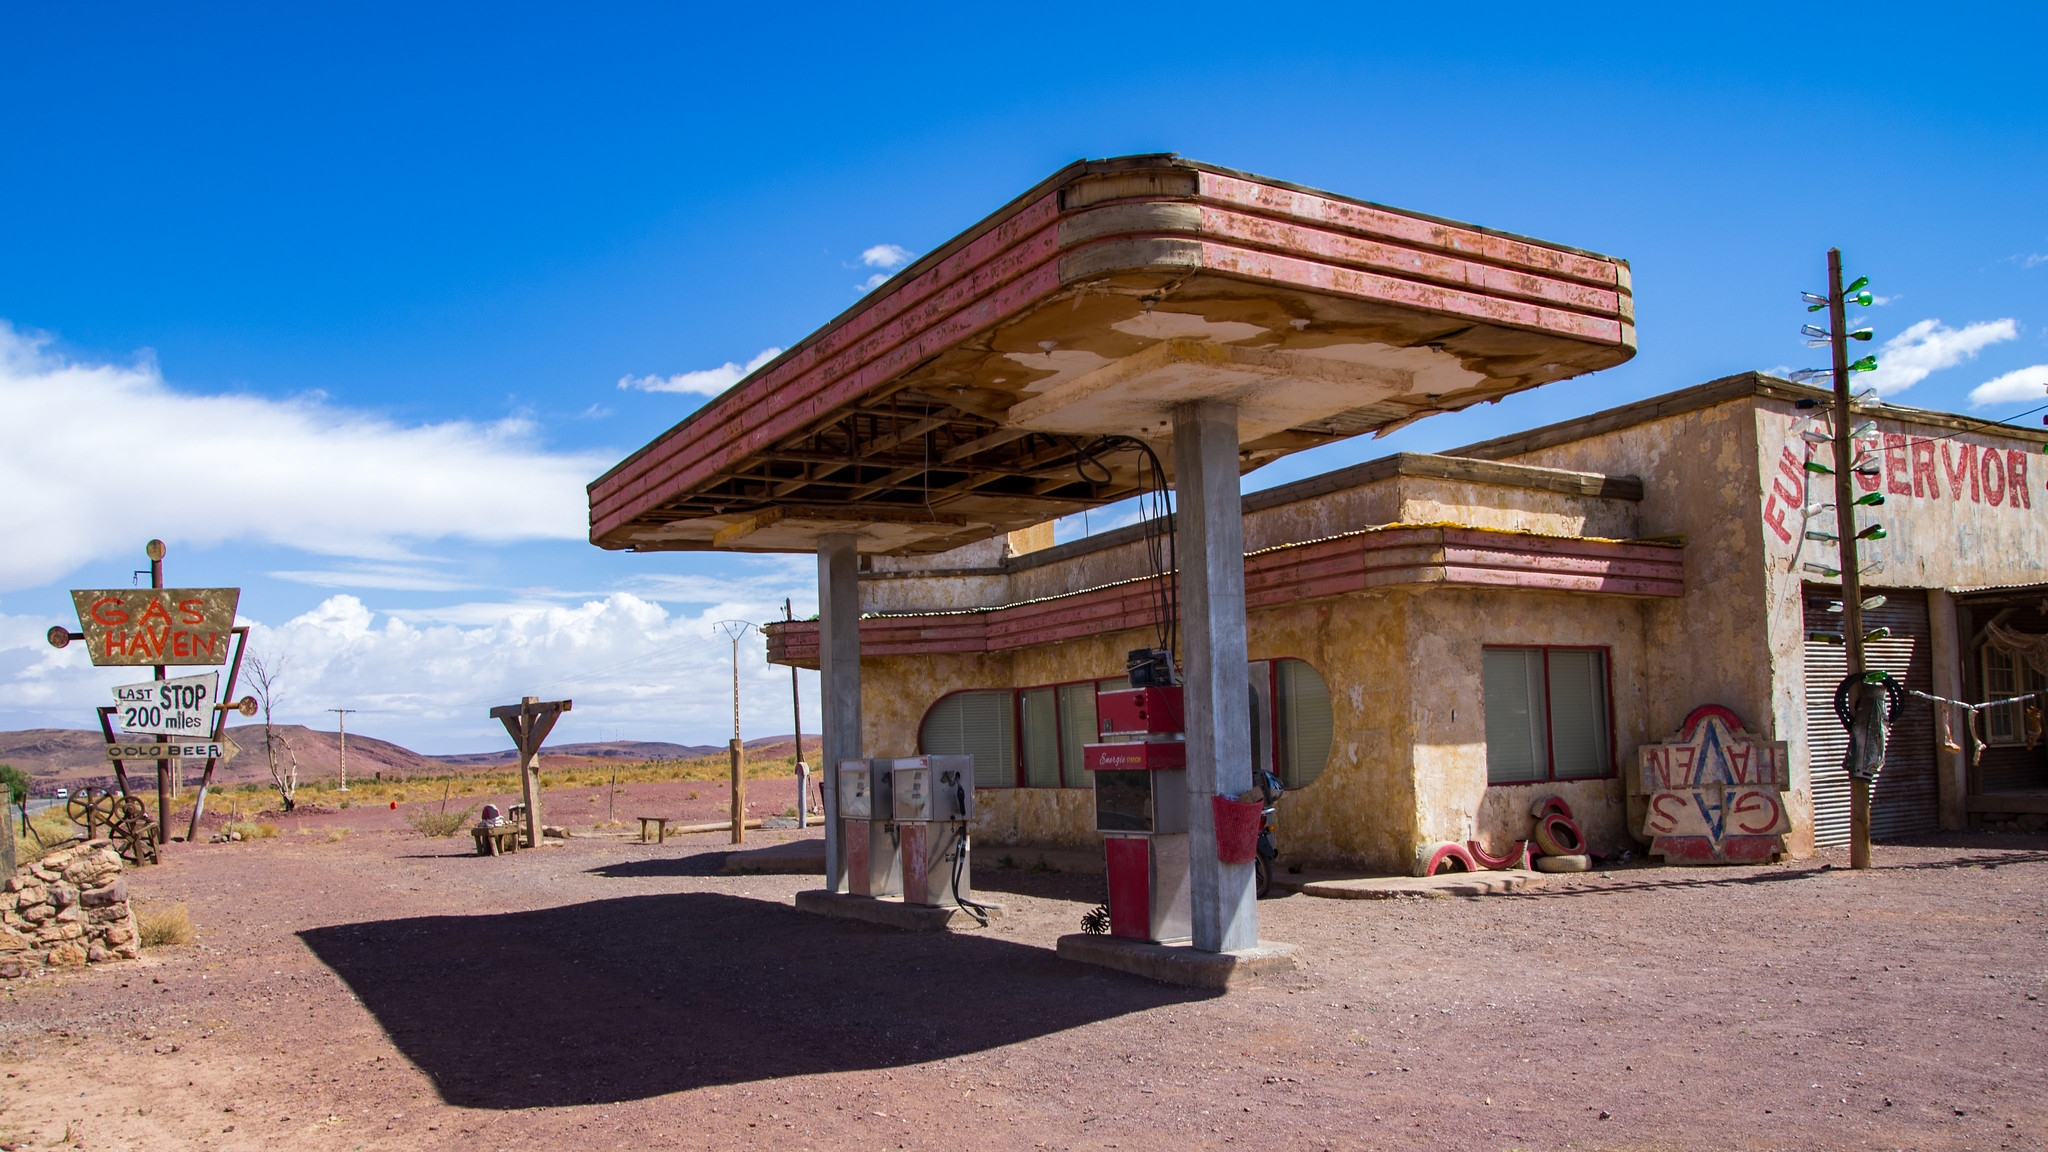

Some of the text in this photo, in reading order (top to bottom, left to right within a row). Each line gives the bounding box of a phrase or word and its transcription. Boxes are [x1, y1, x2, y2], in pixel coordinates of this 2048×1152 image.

[90, 597, 204, 626] GAS
[105, 624, 216, 658] HAVEN
[118, 684, 207, 711] LAST STOP
[125, 706, 202, 729] 200 miles
[1646, 719, 1776, 791] HAVEN
[1650, 791, 1779, 843] GAS
